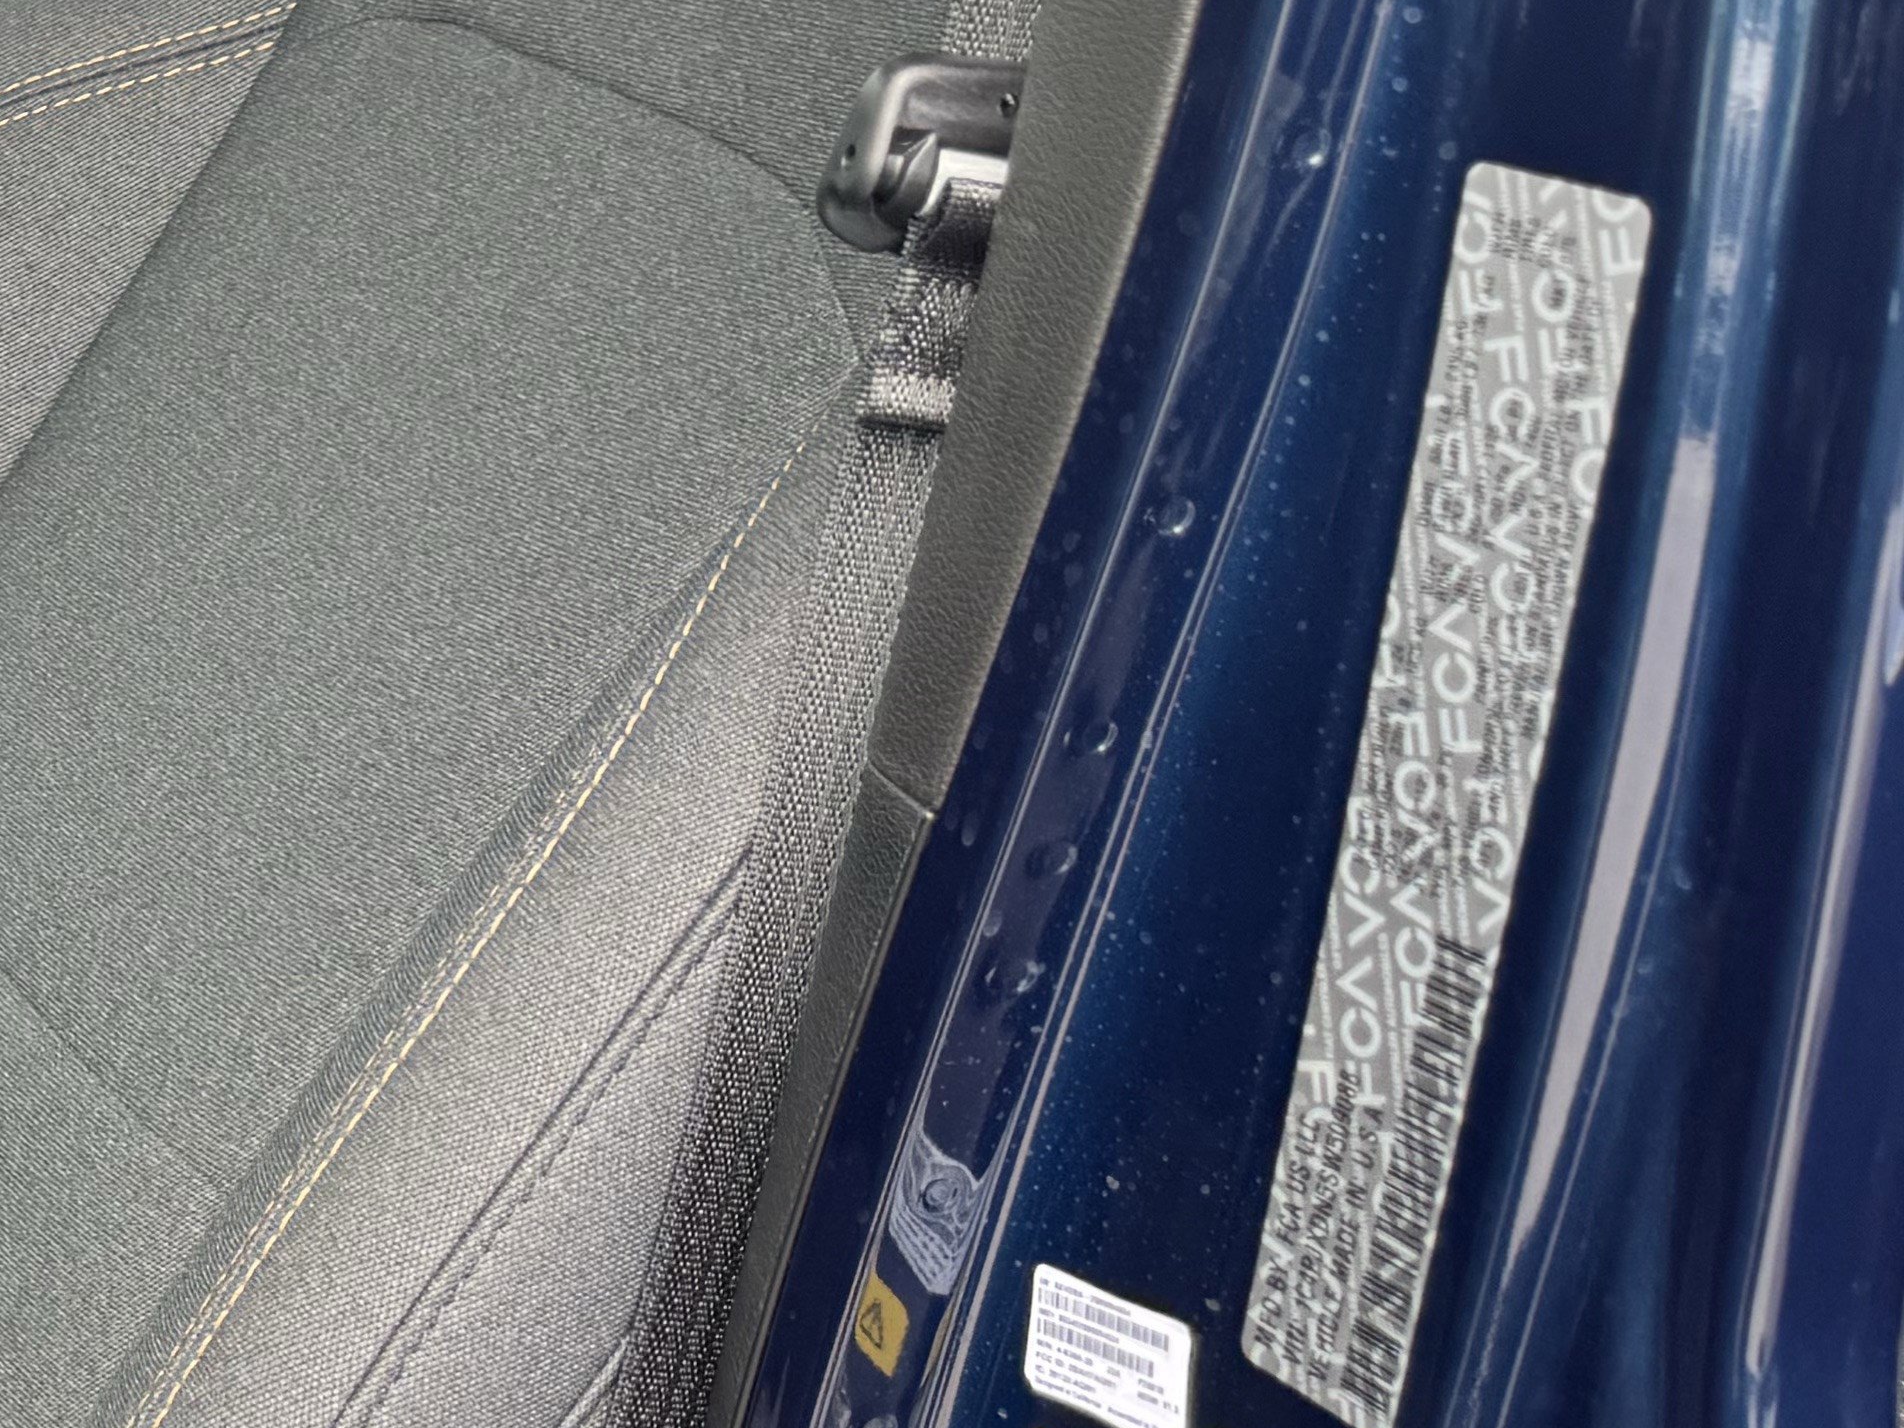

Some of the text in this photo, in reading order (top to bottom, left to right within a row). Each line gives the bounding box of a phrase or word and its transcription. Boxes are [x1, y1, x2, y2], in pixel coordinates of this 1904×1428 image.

[1293, 1111, 1321, 1160] LLC
[1285, 1157, 1311, 1199] US
[1275, 1196, 1303, 1248] FCA
[1254, 1293, 1282, 1352] MFD
[1306, 1282, 1345, 1388] VEHICLE
[1328, 1212, 1361, 1285] MADE
